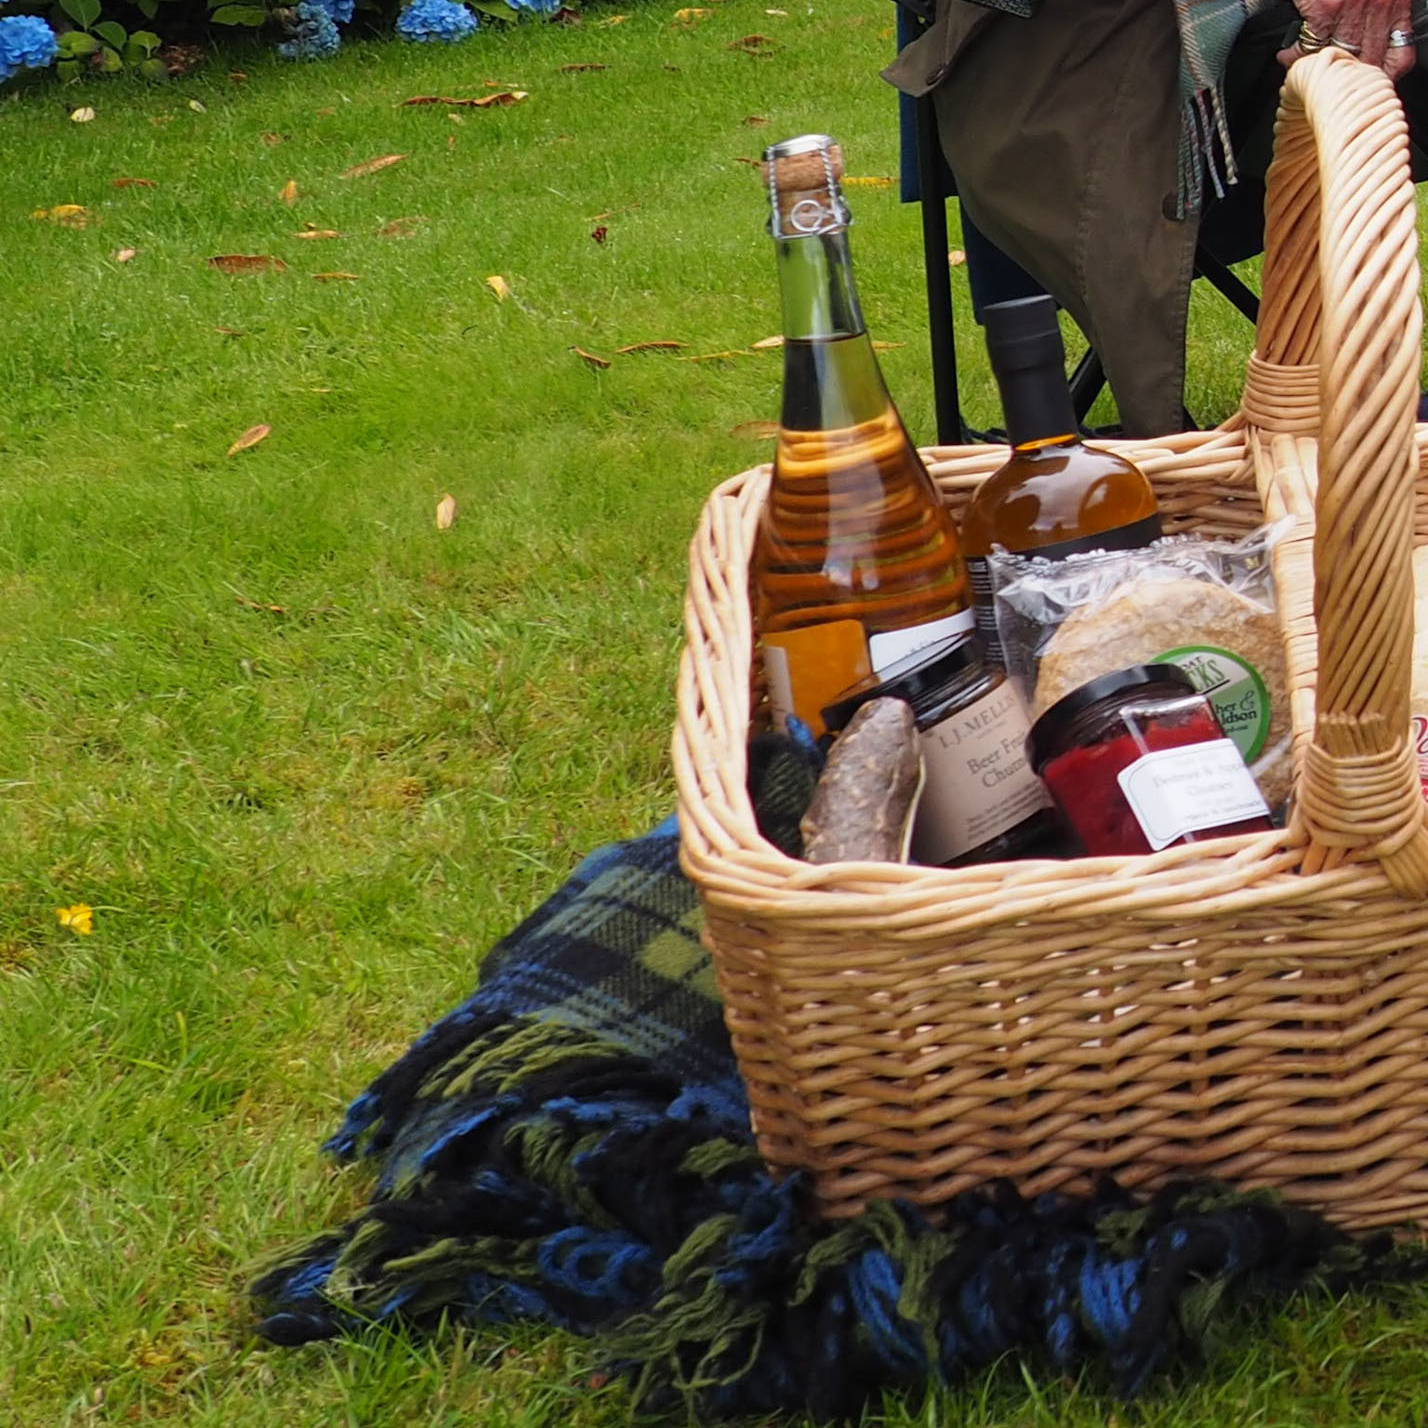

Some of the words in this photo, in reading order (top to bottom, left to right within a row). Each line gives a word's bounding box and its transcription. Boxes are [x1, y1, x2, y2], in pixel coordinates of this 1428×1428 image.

[1187, 659, 1225, 692] CKS
[1215, 702, 1237, 713] her
[1222, 709, 1257, 726] ldson
